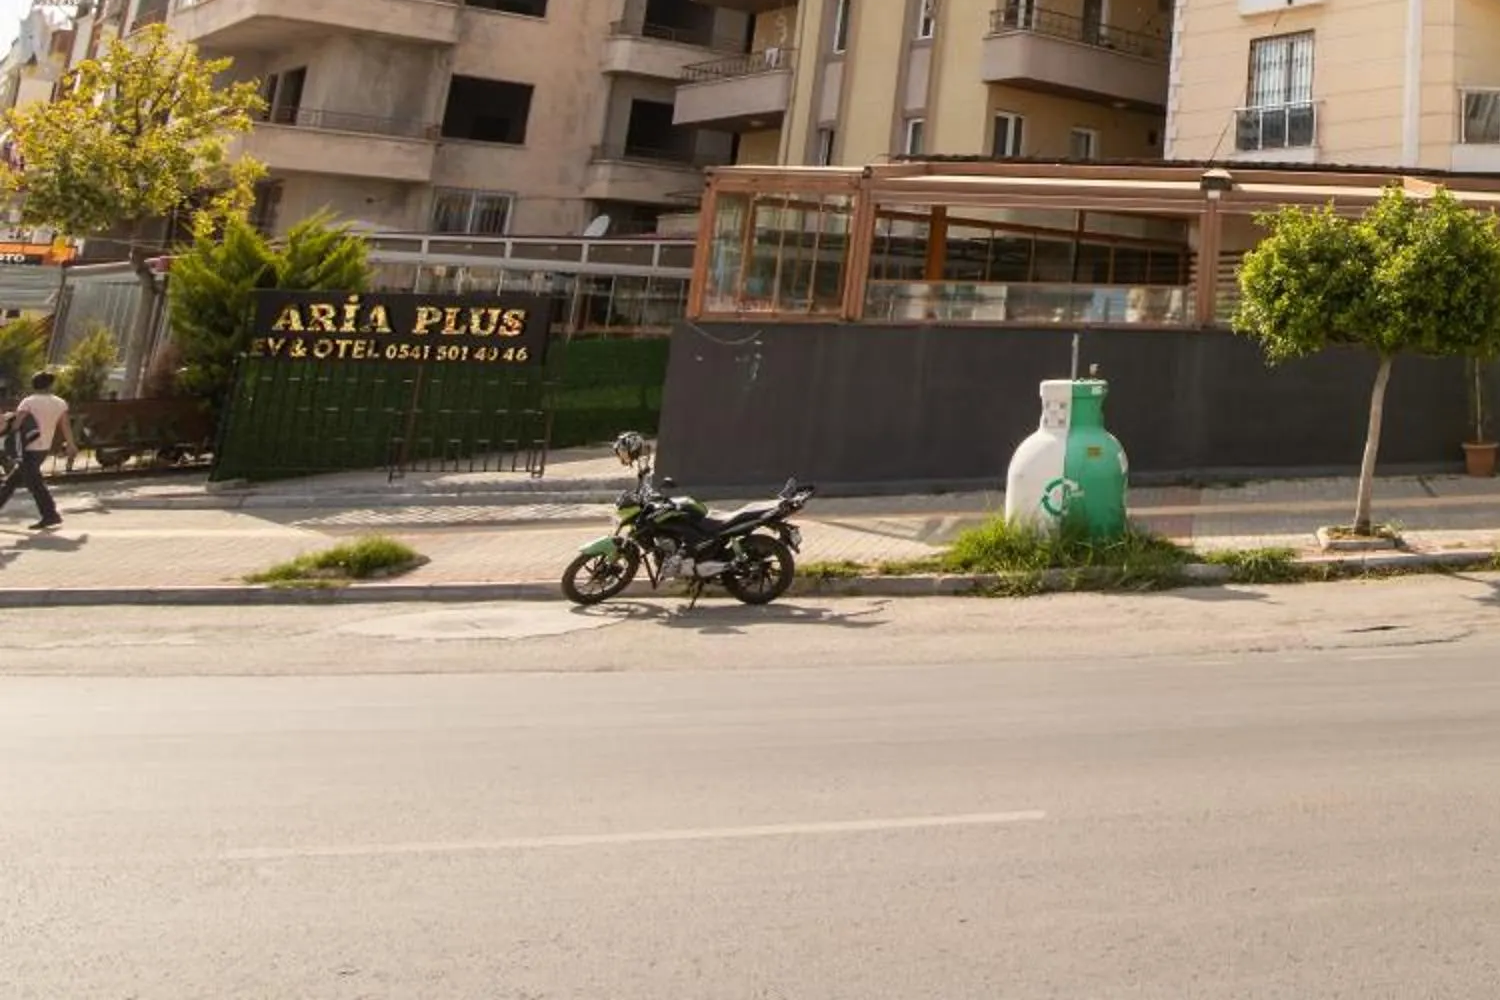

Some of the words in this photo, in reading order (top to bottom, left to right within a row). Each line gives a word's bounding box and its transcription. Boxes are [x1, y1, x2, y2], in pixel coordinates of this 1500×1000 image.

[411, 305, 527, 337] PLUS
[290, 337, 308, 359] &
[313, 338, 381, 360] OTEL
[385, 343, 432, 360] 0541
[503, 346, 530, 361] 46
